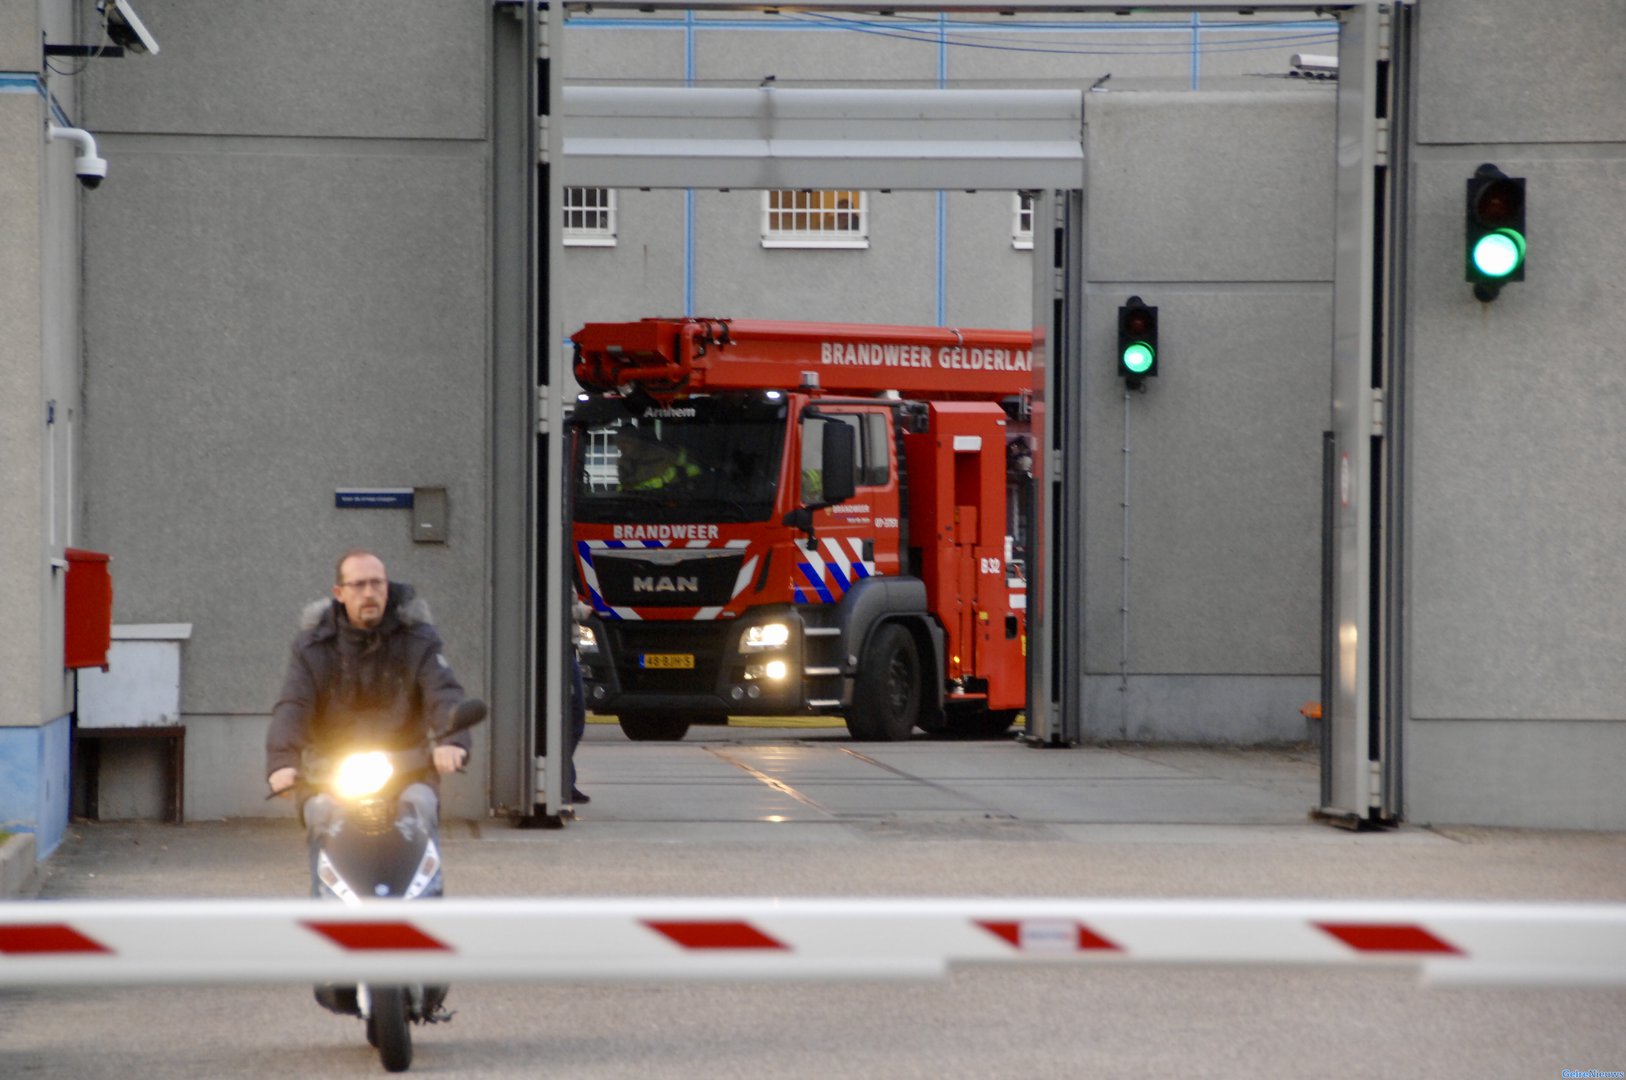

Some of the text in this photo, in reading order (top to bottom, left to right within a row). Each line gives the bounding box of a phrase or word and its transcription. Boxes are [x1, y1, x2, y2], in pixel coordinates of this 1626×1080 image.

[820, 342, 932, 368] BRANDWEER
[643, 406, 696, 418] Arnhem
[613, 524, 719, 540] BRANDWEER
[632, 576, 699, 592] MAN
